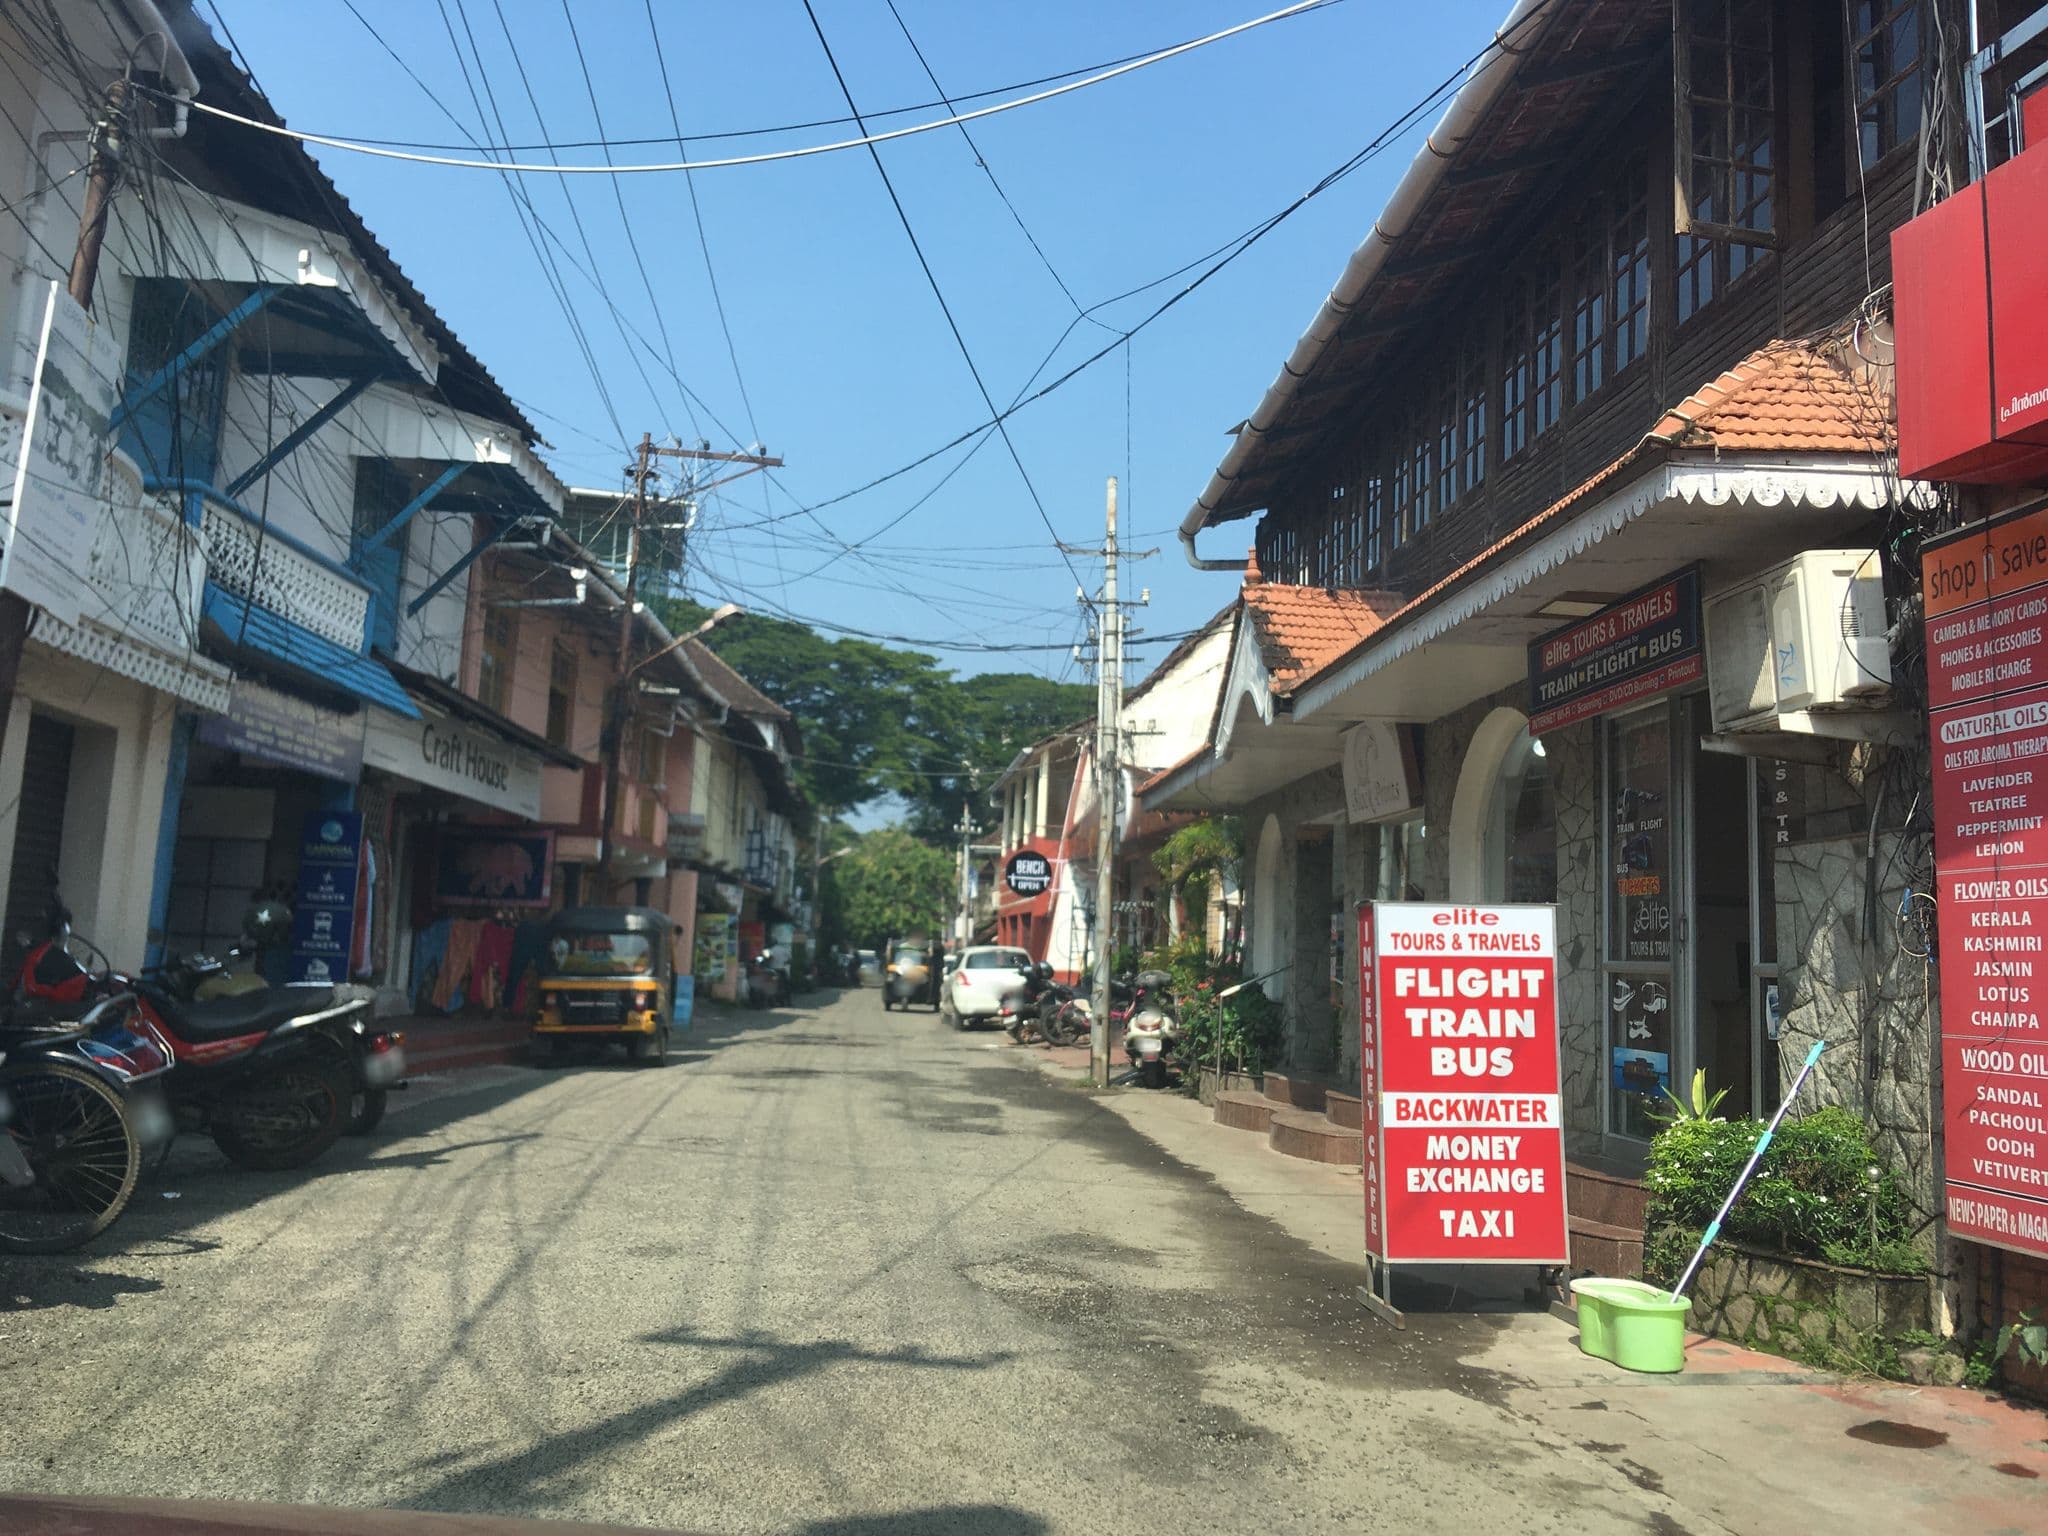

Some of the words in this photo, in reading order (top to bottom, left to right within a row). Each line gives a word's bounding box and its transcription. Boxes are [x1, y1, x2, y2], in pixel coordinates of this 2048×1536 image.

[1931, 559, 1976, 600] shop
[2002, 535, 2048, 576] save
[1545, 641, 1571, 666] elite
[1572, 623, 1606, 652] TOURS
[1608, 617, 1616, 639] &
[1620, 590, 1672, 632] TRAVELS
[1933, 621, 1967, 645] CAMERA
[1968, 619, 1976, 634] &
[2016, 597, 2047, 621] CARDS
[1940, 644, 1974, 669] PHONES
[1975, 643, 1982, 659] &
[1983, 626, 2042, 658] ACCESSORIES
[1539, 671, 1578, 701] TRAIN
[1586, 646, 1639, 683] FLIGHT
[1649, 628, 1682, 659] BUS
[1667, 661, 1696, 682] Printout
[1951, 667, 1985, 692] MOBILE
[1945, 712, 2011, 742] NATURAL
[2013, 704, 2048, 727] OILS
[422, 723, 462, 774] Craft
[466, 741, 509, 792] House
[1944, 751, 1962, 769] OILS
[1963, 749, 1981, 766] FOR
[1981, 743, 2013, 763] AROMA
[1962, 771, 2033, 793] LAVENDER
[1775, 791, 1788, 803] &
[1969, 794, 2028, 814] TEATREE
[1616, 822, 1635, 834] TRAIN
[1640, 818, 1663, 831] FLIGHT
[1957, 815, 2044, 837] PEPPERMINT
[1975, 841, 2024, 857] LEMON
[1016, 859, 1045, 874] BENCH
[1616, 863, 1629, 874] BUS
[1954, 880, 2011, 901] FLOWER
[2014, 878, 2048, 897] OILS
[1432, 908, 1500, 927] elite
[1971, 910, 2032, 927] KERALA
[1391, 932, 1446, 951] TOURS
[1452, 932, 1463, 951] &
[1468, 932, 1541, 952] TRAVELS
[1630, 941, 1649, 956] TOURS
[1964, 936, 2042, 952] KASHMIRI
[1973, 961, 2033, 977] JASMIN
[1394, 967, 1545, 999] FLIGHT
[1979, 986, 2029, 1003] LOTUS
[1404, 1007, 1536, 1038] TRAIN
[1971, 1011, 2040, 1029] CHAMPA
[1430, 1046, 1515, 1077] BUS
[1961, 1048, 2015, 1073] WOOD
[1976, 1085, 2043, 1108] SANDAL
[1395, 1098, 1548, 1122] BACKWATER
[1969, 1109, 2048, 1135] PACHOUL
[1426, 1135, 1521, 1161] MONEY
[1986, 1136, 2035, 1159] OODH
[1406, 1167, 1545, 1194] EXCHANGE
[1973, 1158, 2048, 1187] VETIVERT
[1439, 1209, 1515, 1238] TAXI
[1949, 1196, 1977, 1227] NEWS
[1977, 1201, 2009, 1234] PAPER
[2009, 1214, 2017, 1235] &
